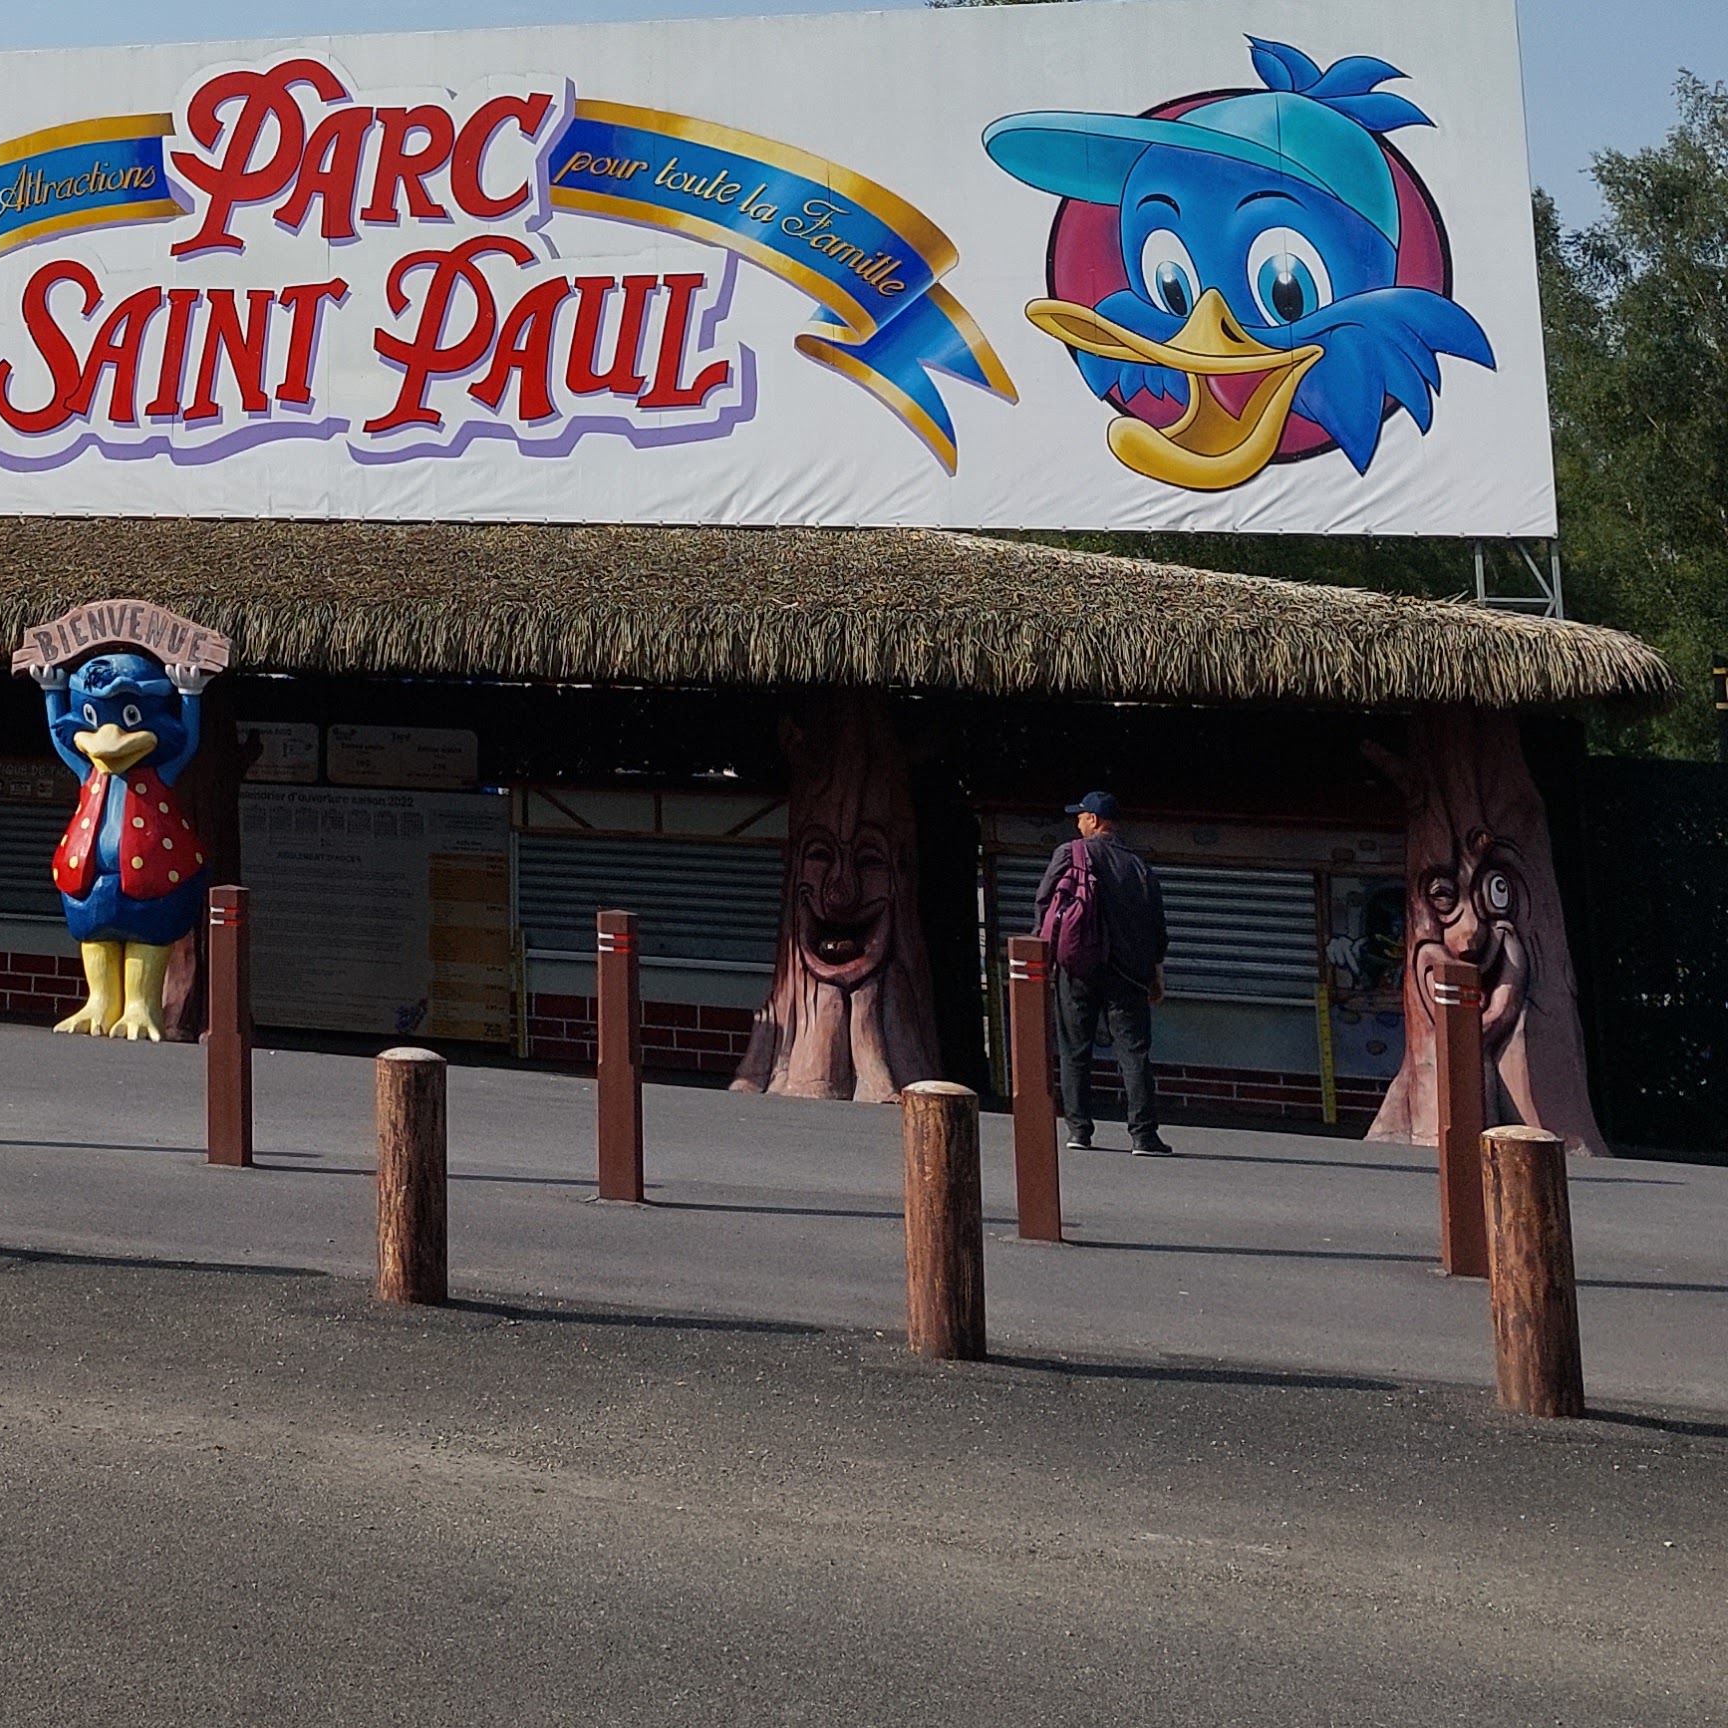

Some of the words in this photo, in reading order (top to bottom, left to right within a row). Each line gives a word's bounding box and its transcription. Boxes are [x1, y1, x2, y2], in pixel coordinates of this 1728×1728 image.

[171, 59, 553, 257] PARC
[552, 150, 650, 185] pour
[654, 156, 742, 205] toute
[737, 182, 777, 224] la
[780, 198, 908, 298] Famille
[363, 235, 730, 433] PAUL
[32, 603, 209, 663] BIENVENUE
[31, 764, 47, 776] DE
